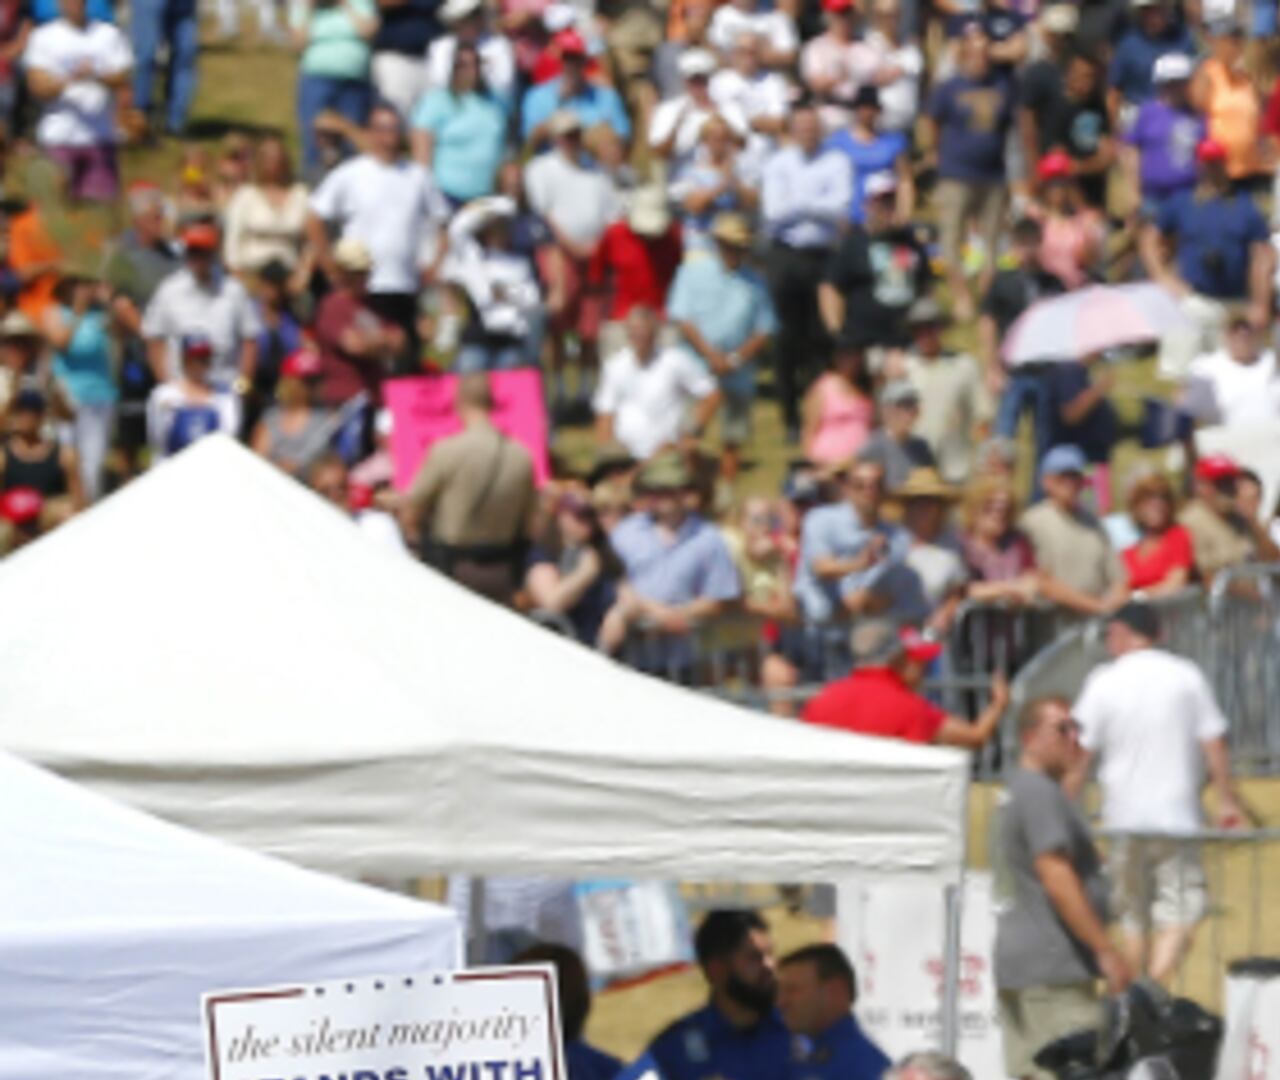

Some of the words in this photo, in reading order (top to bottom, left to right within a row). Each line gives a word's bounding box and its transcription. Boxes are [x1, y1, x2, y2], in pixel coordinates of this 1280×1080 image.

[227, 1024, 280, 1062] the
[288, 1016, 381, 1055] silent
[388, 1005, 541, 1056] majority
